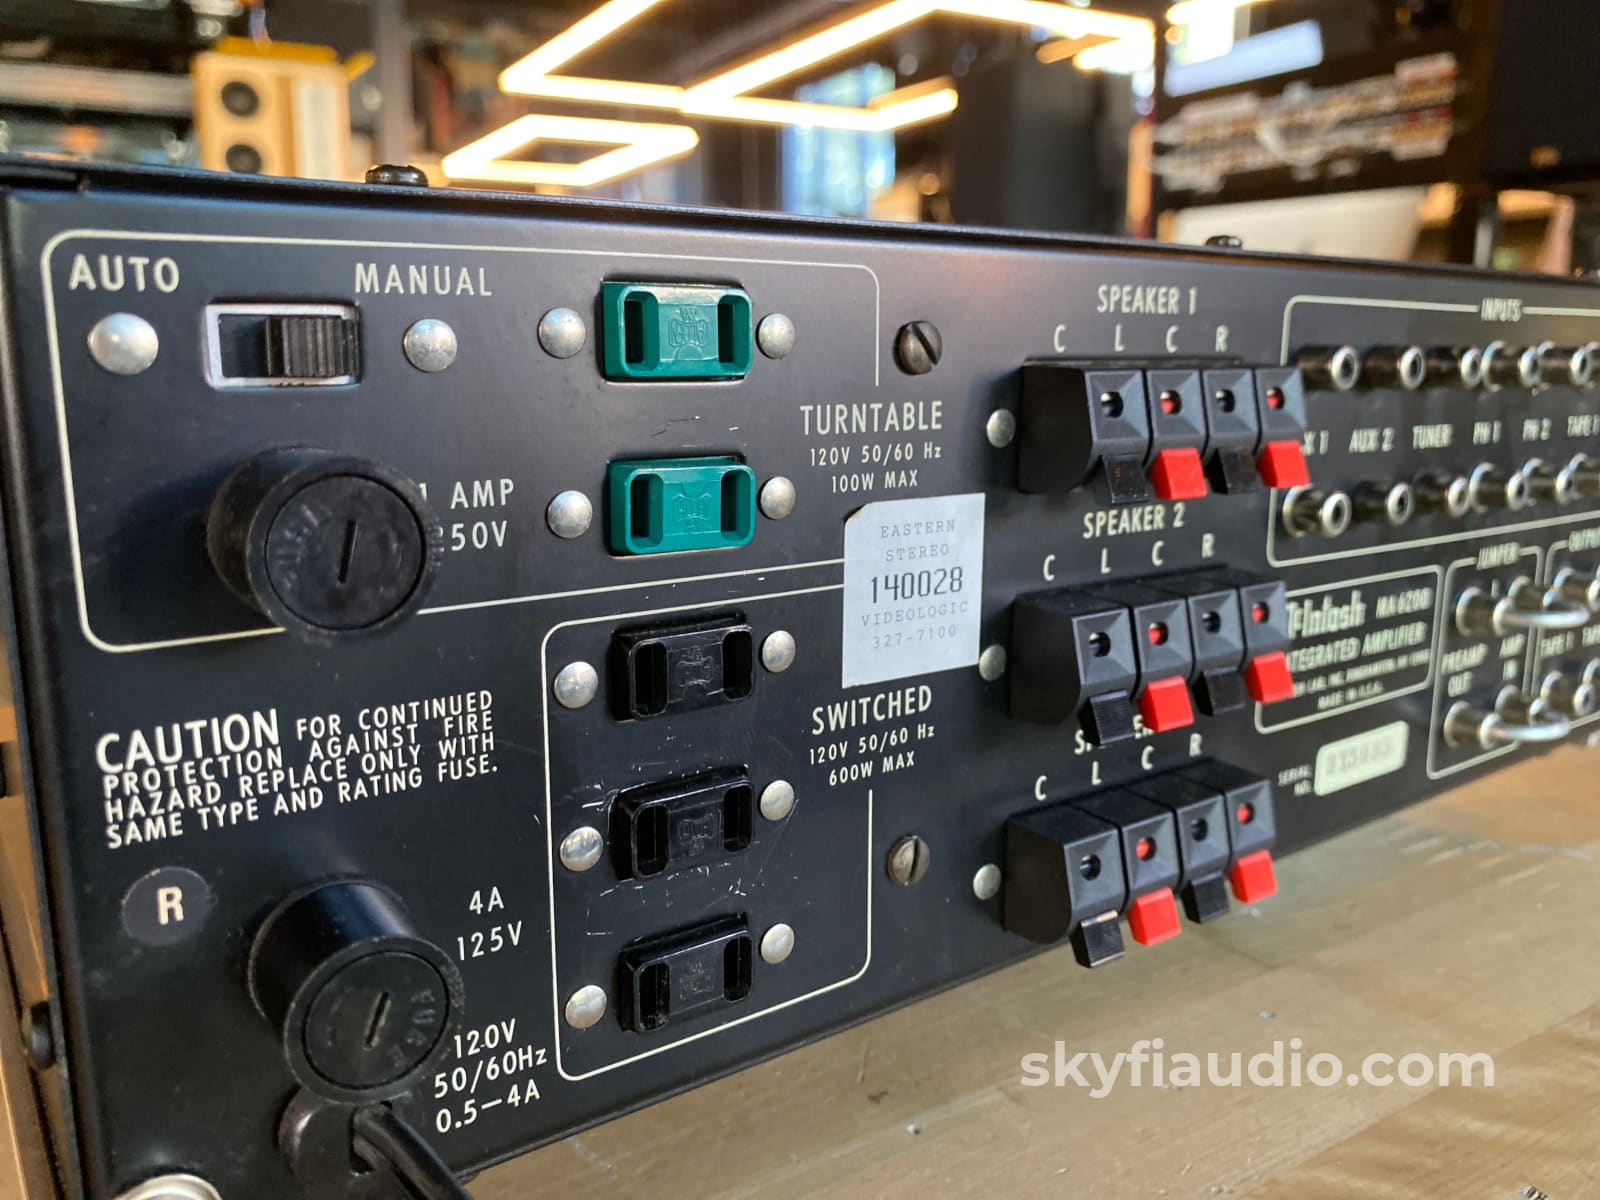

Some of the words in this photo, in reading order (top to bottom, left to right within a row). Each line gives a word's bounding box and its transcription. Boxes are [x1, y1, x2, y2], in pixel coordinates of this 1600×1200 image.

[68, 254, 180, 293] AUTO
[354, 262, 493, 297] MANUAL
[1096, 284, 1180, 315] SPEAKER
[1188, 286, 1198, 316] 1
[1481, 297, 1522, 322] INPUTS
[1053, 323, 1067, 353] C
[1113, 323, 1125, 352] L
[1165, 324, 1179, 354] C
[1214, 325, 1229, 352] R
[799, 400, 943, 436] TURNTABLE
[1493, 420, 1501, 443] 1
[1540, 417, 1552, 440] 2
[810, 446, 850, 466] 120V
[861, 443, 914, 466] 50/60
[923, 441, 942, 459] Hz
[1349, 428, 1382, 453] AUX
[1383, 427, 1395, 452] 2
[1412, 424, 1453, 449] TUNER
[450, 478, 515, 510] AMP
[831, 473, 875, 494] 100W
[884, 469, 919, 489] MAX
[880, 519, 956, 538] EASTERN
[1082, 504, 1165, 540] SPEAKER
[1173, 502, 1186, 528] 2
[885, 543, 950, 562] STEREO
[1043, 554, 1055, 582] C
[1100, 548, 1111, 574] L
[1151, 540, 1164, 566] C
[1201, 533, 1215, 558] R
[871, 566, 963, 604] 140028
[861, 600, 969, 627] VIDEOLOGIC
[872, 624, 957, 649] 327-7100
[1286, 637, 1360, 673] TEGRATED
[1361, 620, 1428, 656] AMPLIFIER
[811, 685, 933, 736] SWITCHED
[96, 708, 279, 773] CAUTION
[296, 714, 341, 741] FOR
[358, 689, 492, 730] CONTINUED
[809, 740, 849, 766] 120V
[858, 727, 909, 753] 50/60
[917, 723, 936, 740] Hz
[102, 746, 283, 799] PROTECTION
[309, 723, 418, 762] AGAINST
[444, 710, 492, 737] FIRE
[828, 761, 873, 787] 600W
[882, 751, 915, 774] MAX
[1034, 775, 1048, 800] C
[1091, 760, 1102, 786] L
[1141, 745, 1154, 770] C
[1189, 733, 1202, 757] R
[104, 781, 222, 824] HAZARD
[239, 758, 348, 798] REPLACE
[361, 744, 421, 774] ONLY
[438, 731, 494, 760] WITH
[106, 812, 184, 849] SAME
[197, 798, 259, 831] TYPE
[273, 786, 324, 816] AND
[338, 767, 423, 803] RATING
[437, 754, 498, 783] FUSE.
[155, 886, 185, 925] R
[468, 885, 505, 914] 4A
[456, 920, 524, 962] 125V
[453, 1017, 516, 1059] 120V
[433, 1043, 548, 1099] 50/60Hz
